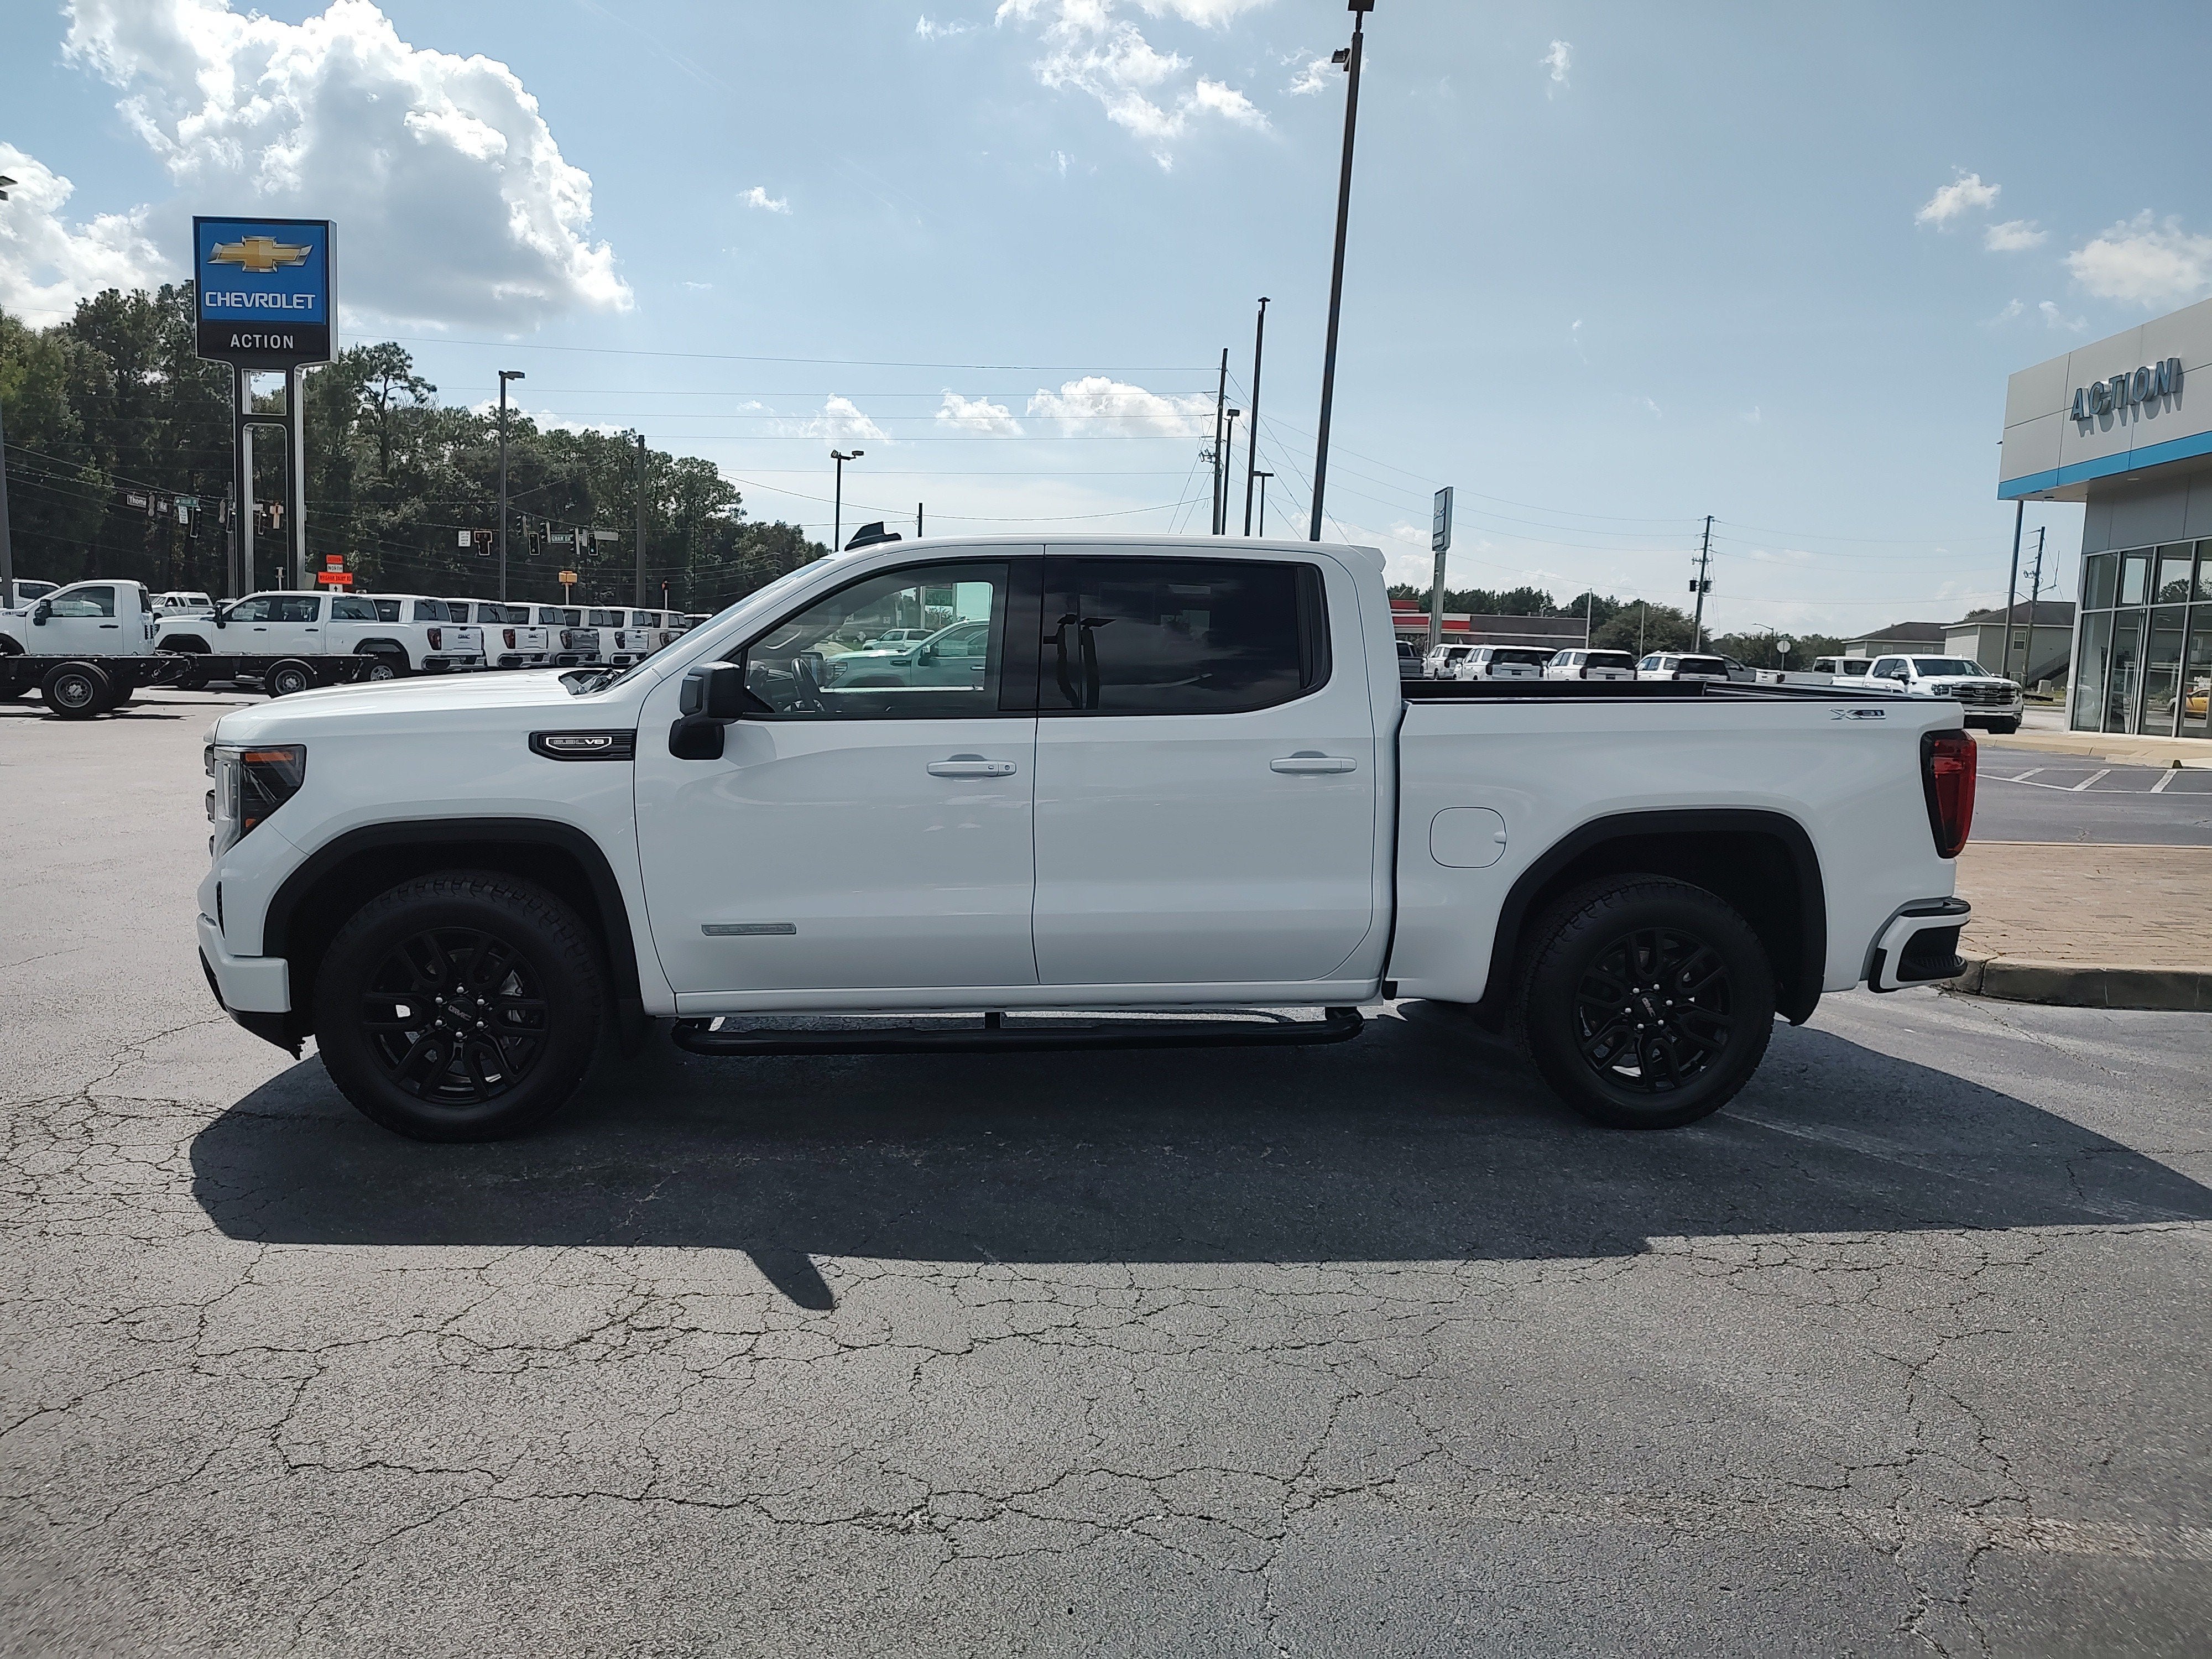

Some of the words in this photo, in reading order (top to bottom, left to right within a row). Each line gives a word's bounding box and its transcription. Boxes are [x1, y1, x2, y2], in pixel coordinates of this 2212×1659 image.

[205, 291, 315, 309] CHEVROLET
[230, 333, 294, 349] ACTION
[2069, 358, 2180, 421] ACTION
[448, 1005, 471, 1021] GMC
